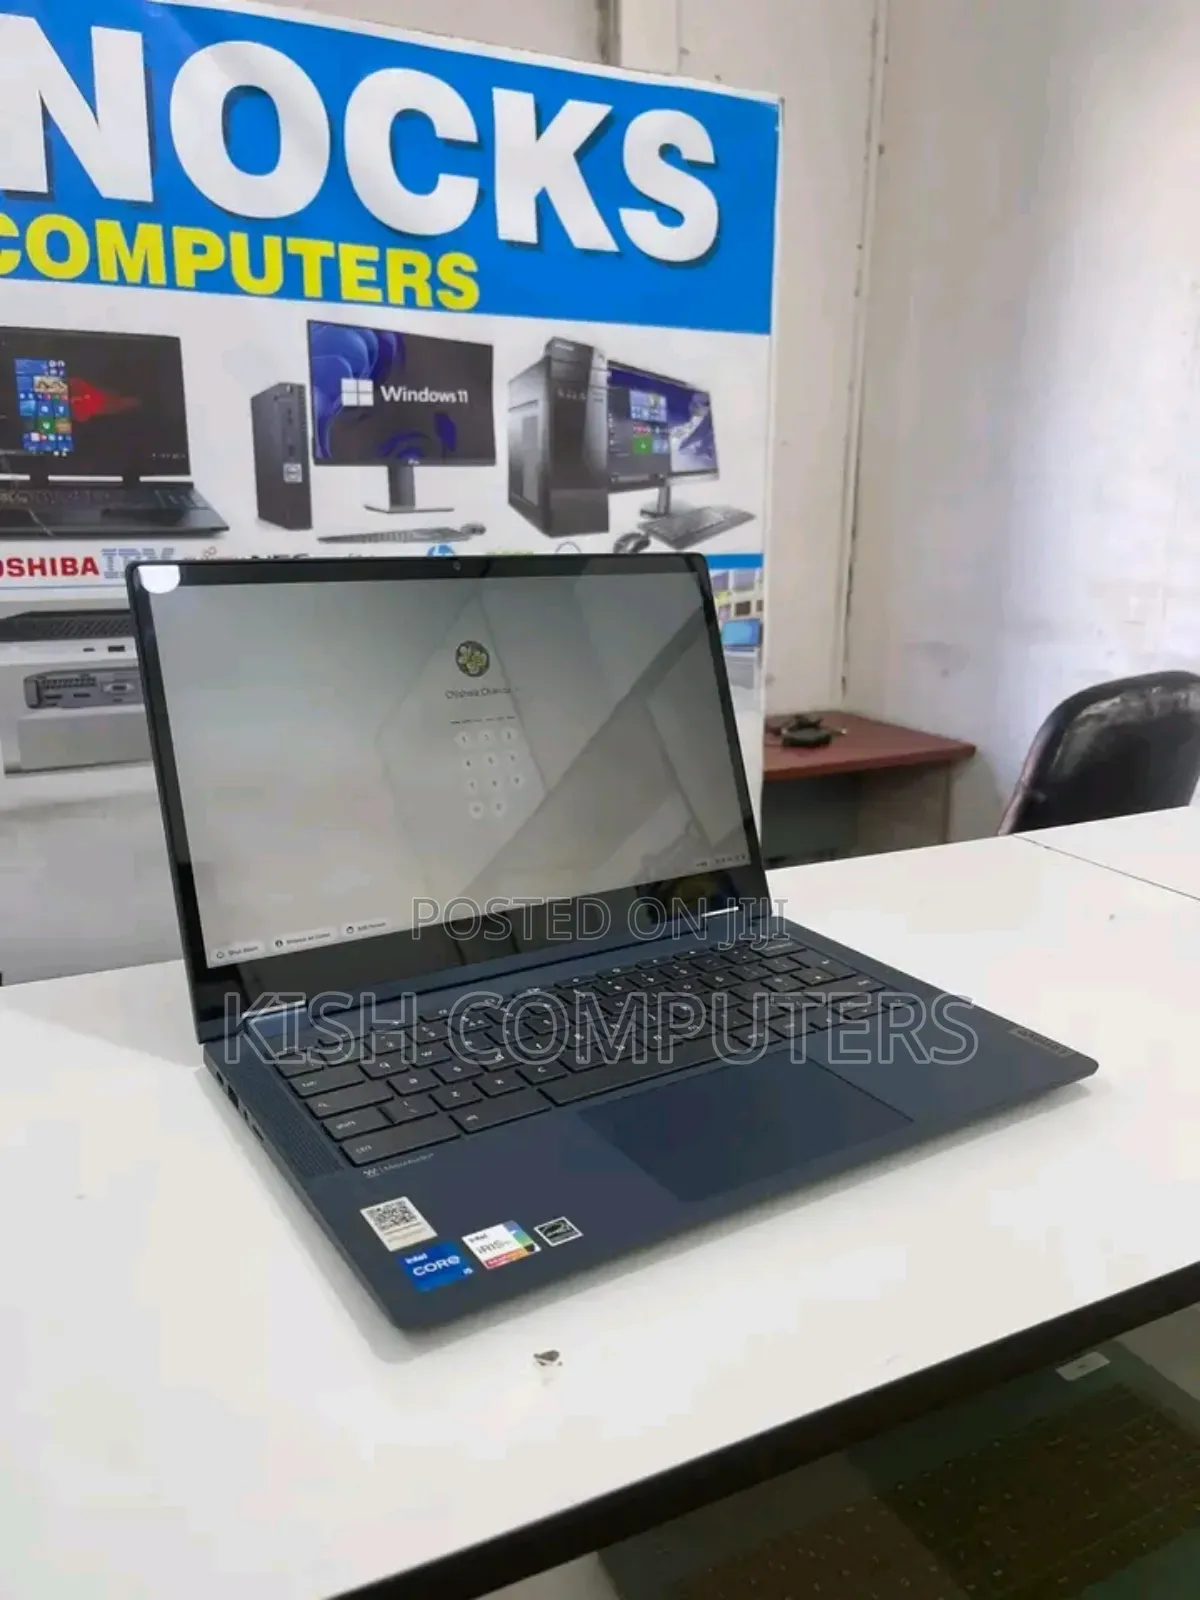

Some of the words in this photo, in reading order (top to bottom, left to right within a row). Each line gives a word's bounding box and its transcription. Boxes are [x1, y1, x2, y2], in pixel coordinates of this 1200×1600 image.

[0, 15, 720, 262] NOCKS
[381, 386, 456, 403] Windows
[0, 556, 99, 578] SHIBA
[405, 1252, 428, 1265] intel
